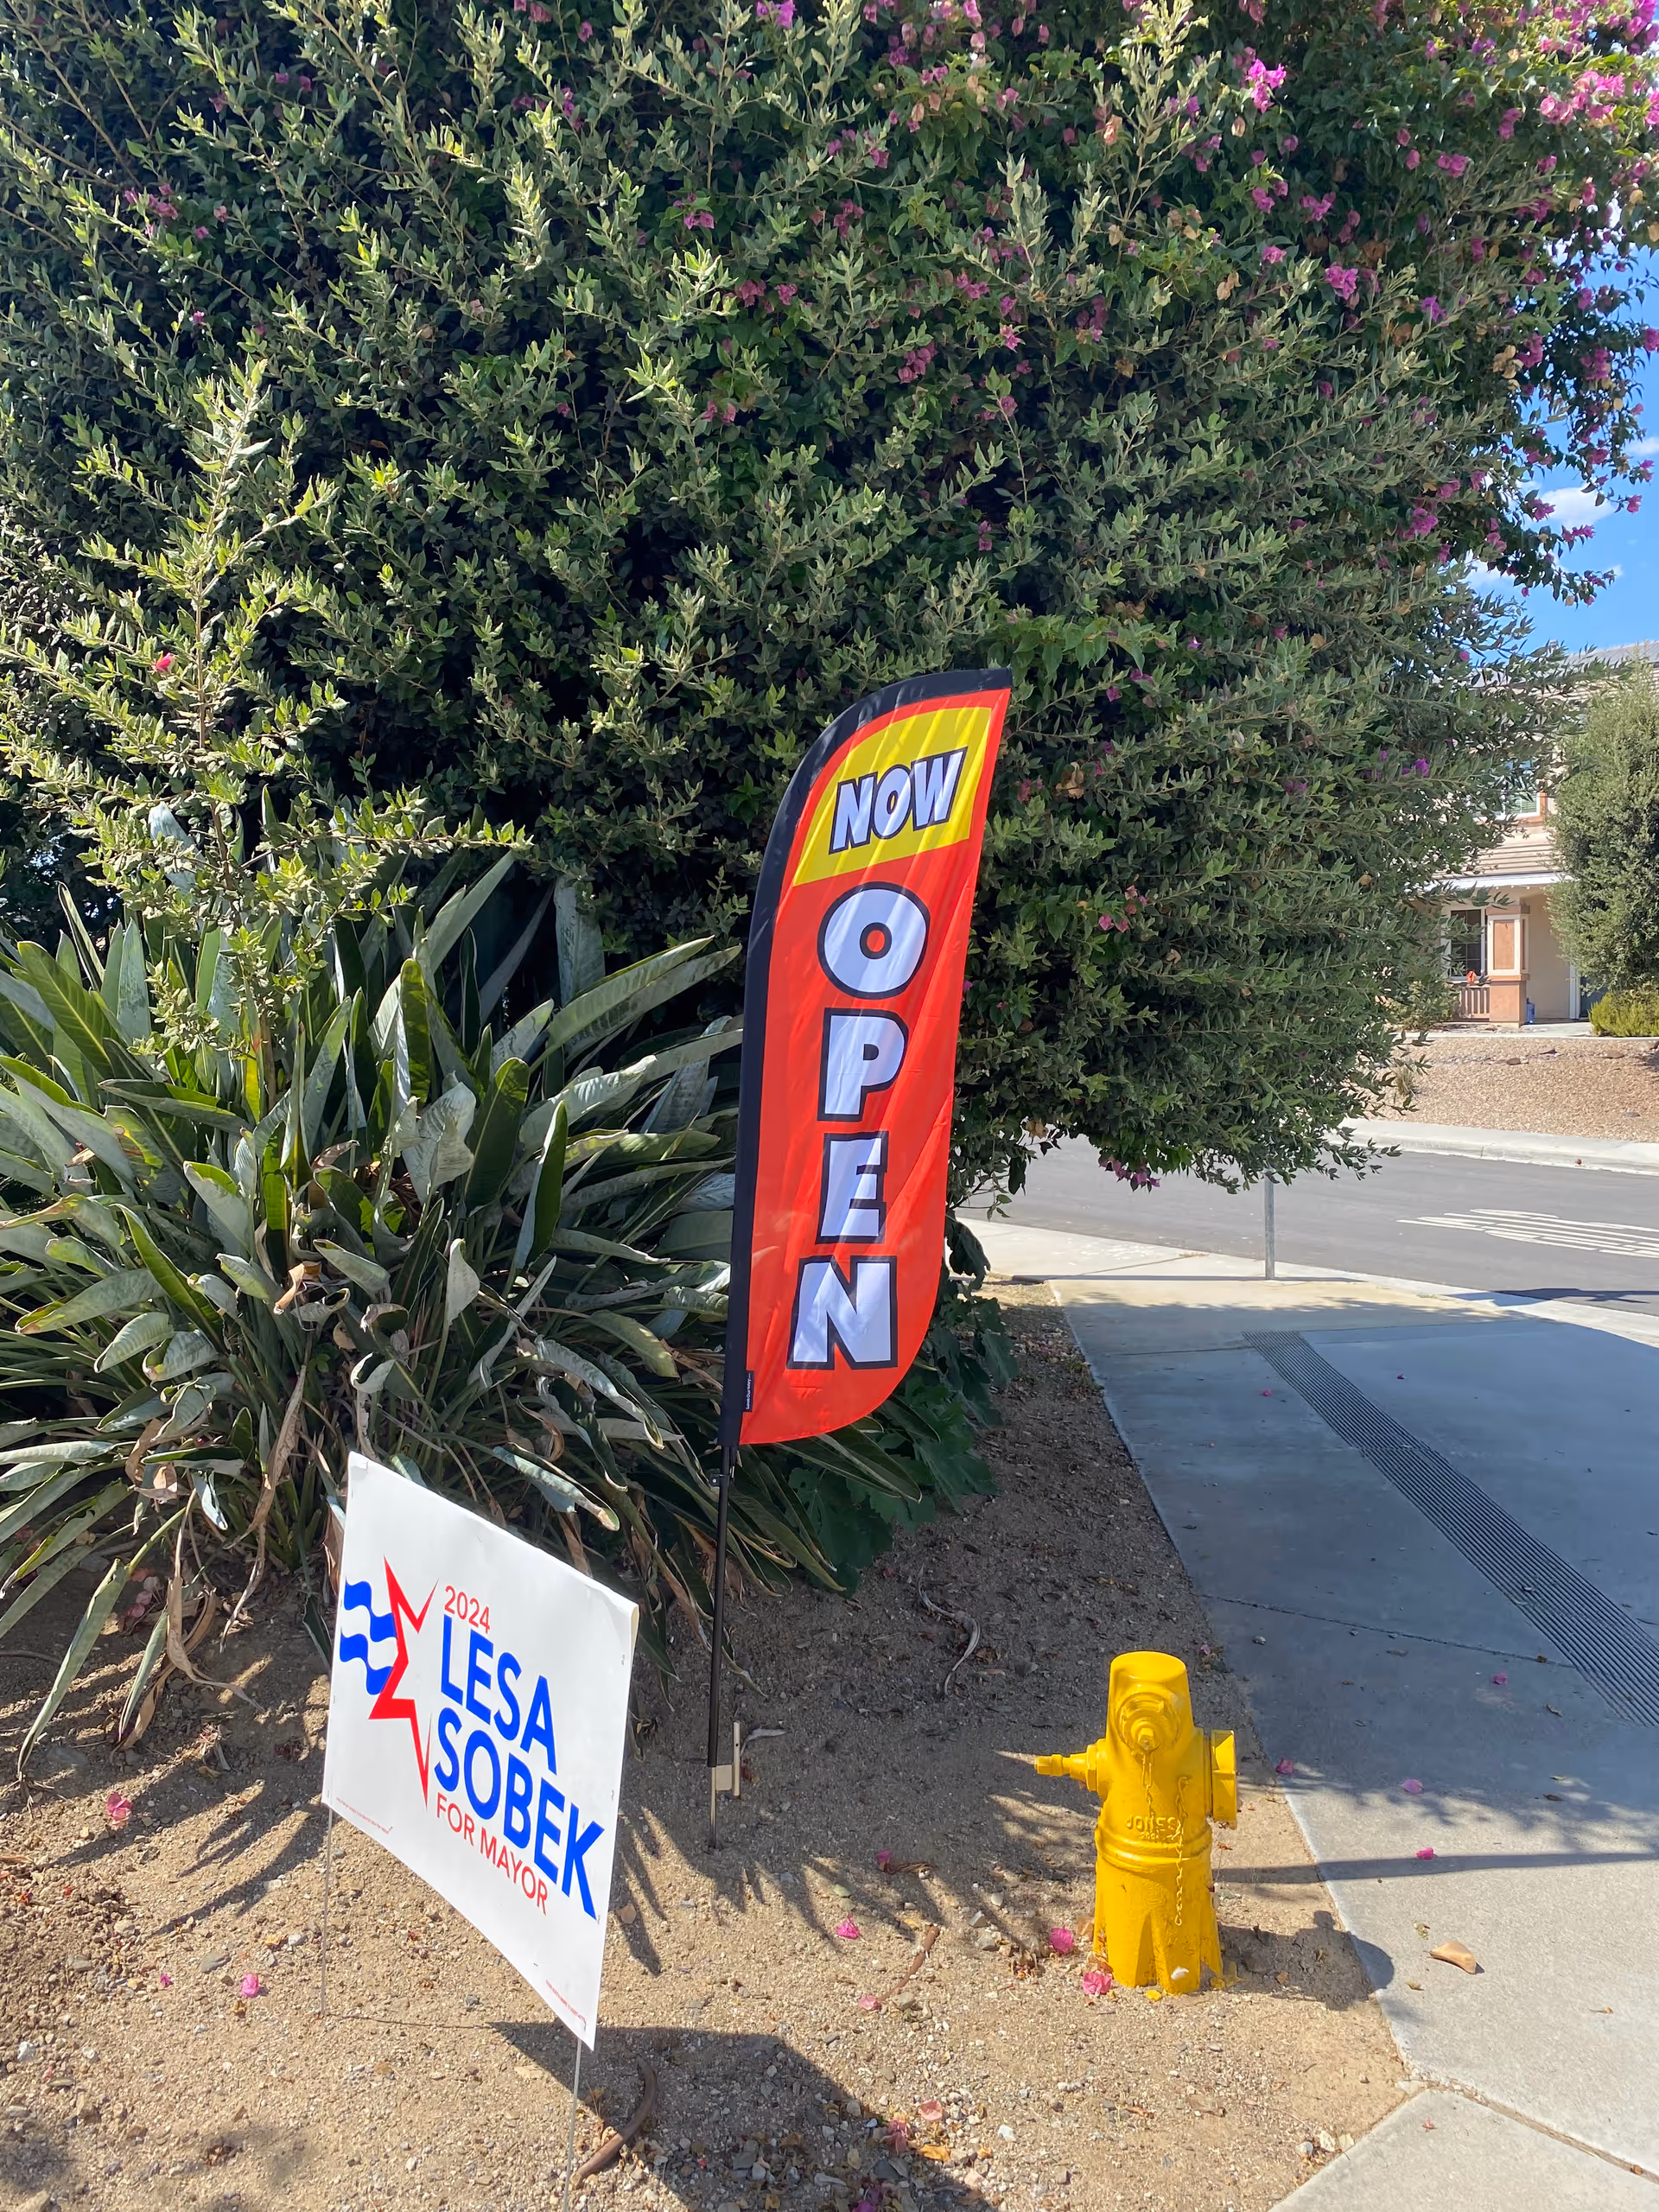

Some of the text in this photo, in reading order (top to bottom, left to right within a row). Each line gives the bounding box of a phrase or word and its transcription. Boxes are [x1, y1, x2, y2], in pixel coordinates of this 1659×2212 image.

[830, 747, 968, 853] NOW
[787, 881, 931, 1370] OPEN
[444, 1585, 491, 1635] 2024
[441, 1614, 557, 1775] LESA
[434, 1707, 605, 1920] SOBEK
[436, 1791, 475, 1847] FOR
[480, 1827, 548, 1916] MAYOR
[1126, 1815, 1177, 1831] JONES
